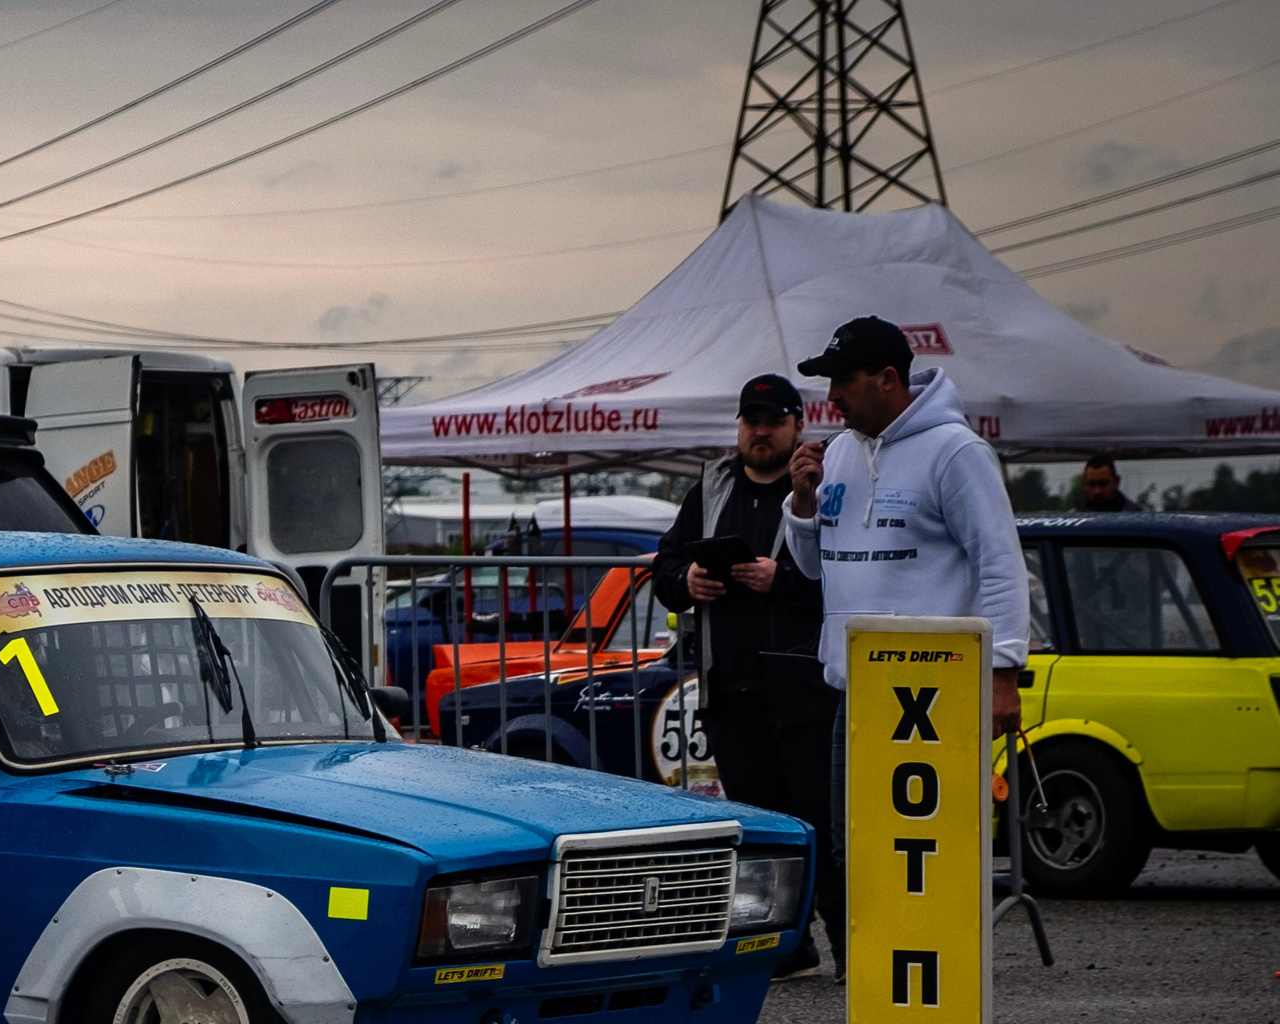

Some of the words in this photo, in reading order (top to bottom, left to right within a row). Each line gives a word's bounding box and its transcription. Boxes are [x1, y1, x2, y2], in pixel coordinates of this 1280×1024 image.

[290, 398, 350, 420] Castrol
[432, 402, 659, 438] www.klotzlube.ru
[78, 480, 106, 507] SPORT
[820, 483, 846, 516] 28
[42, 584, 130, 609] АВТОДРОМ
[126, 583, 258, 608] САНКТ-ПЕТЕРБУРГ
[868, 651, 906, 662] LET'S
[661, 709, 714, 761] 55
[891, 686, 941, 896] ХОТ
[438, 970, 465, 981] LET'S
